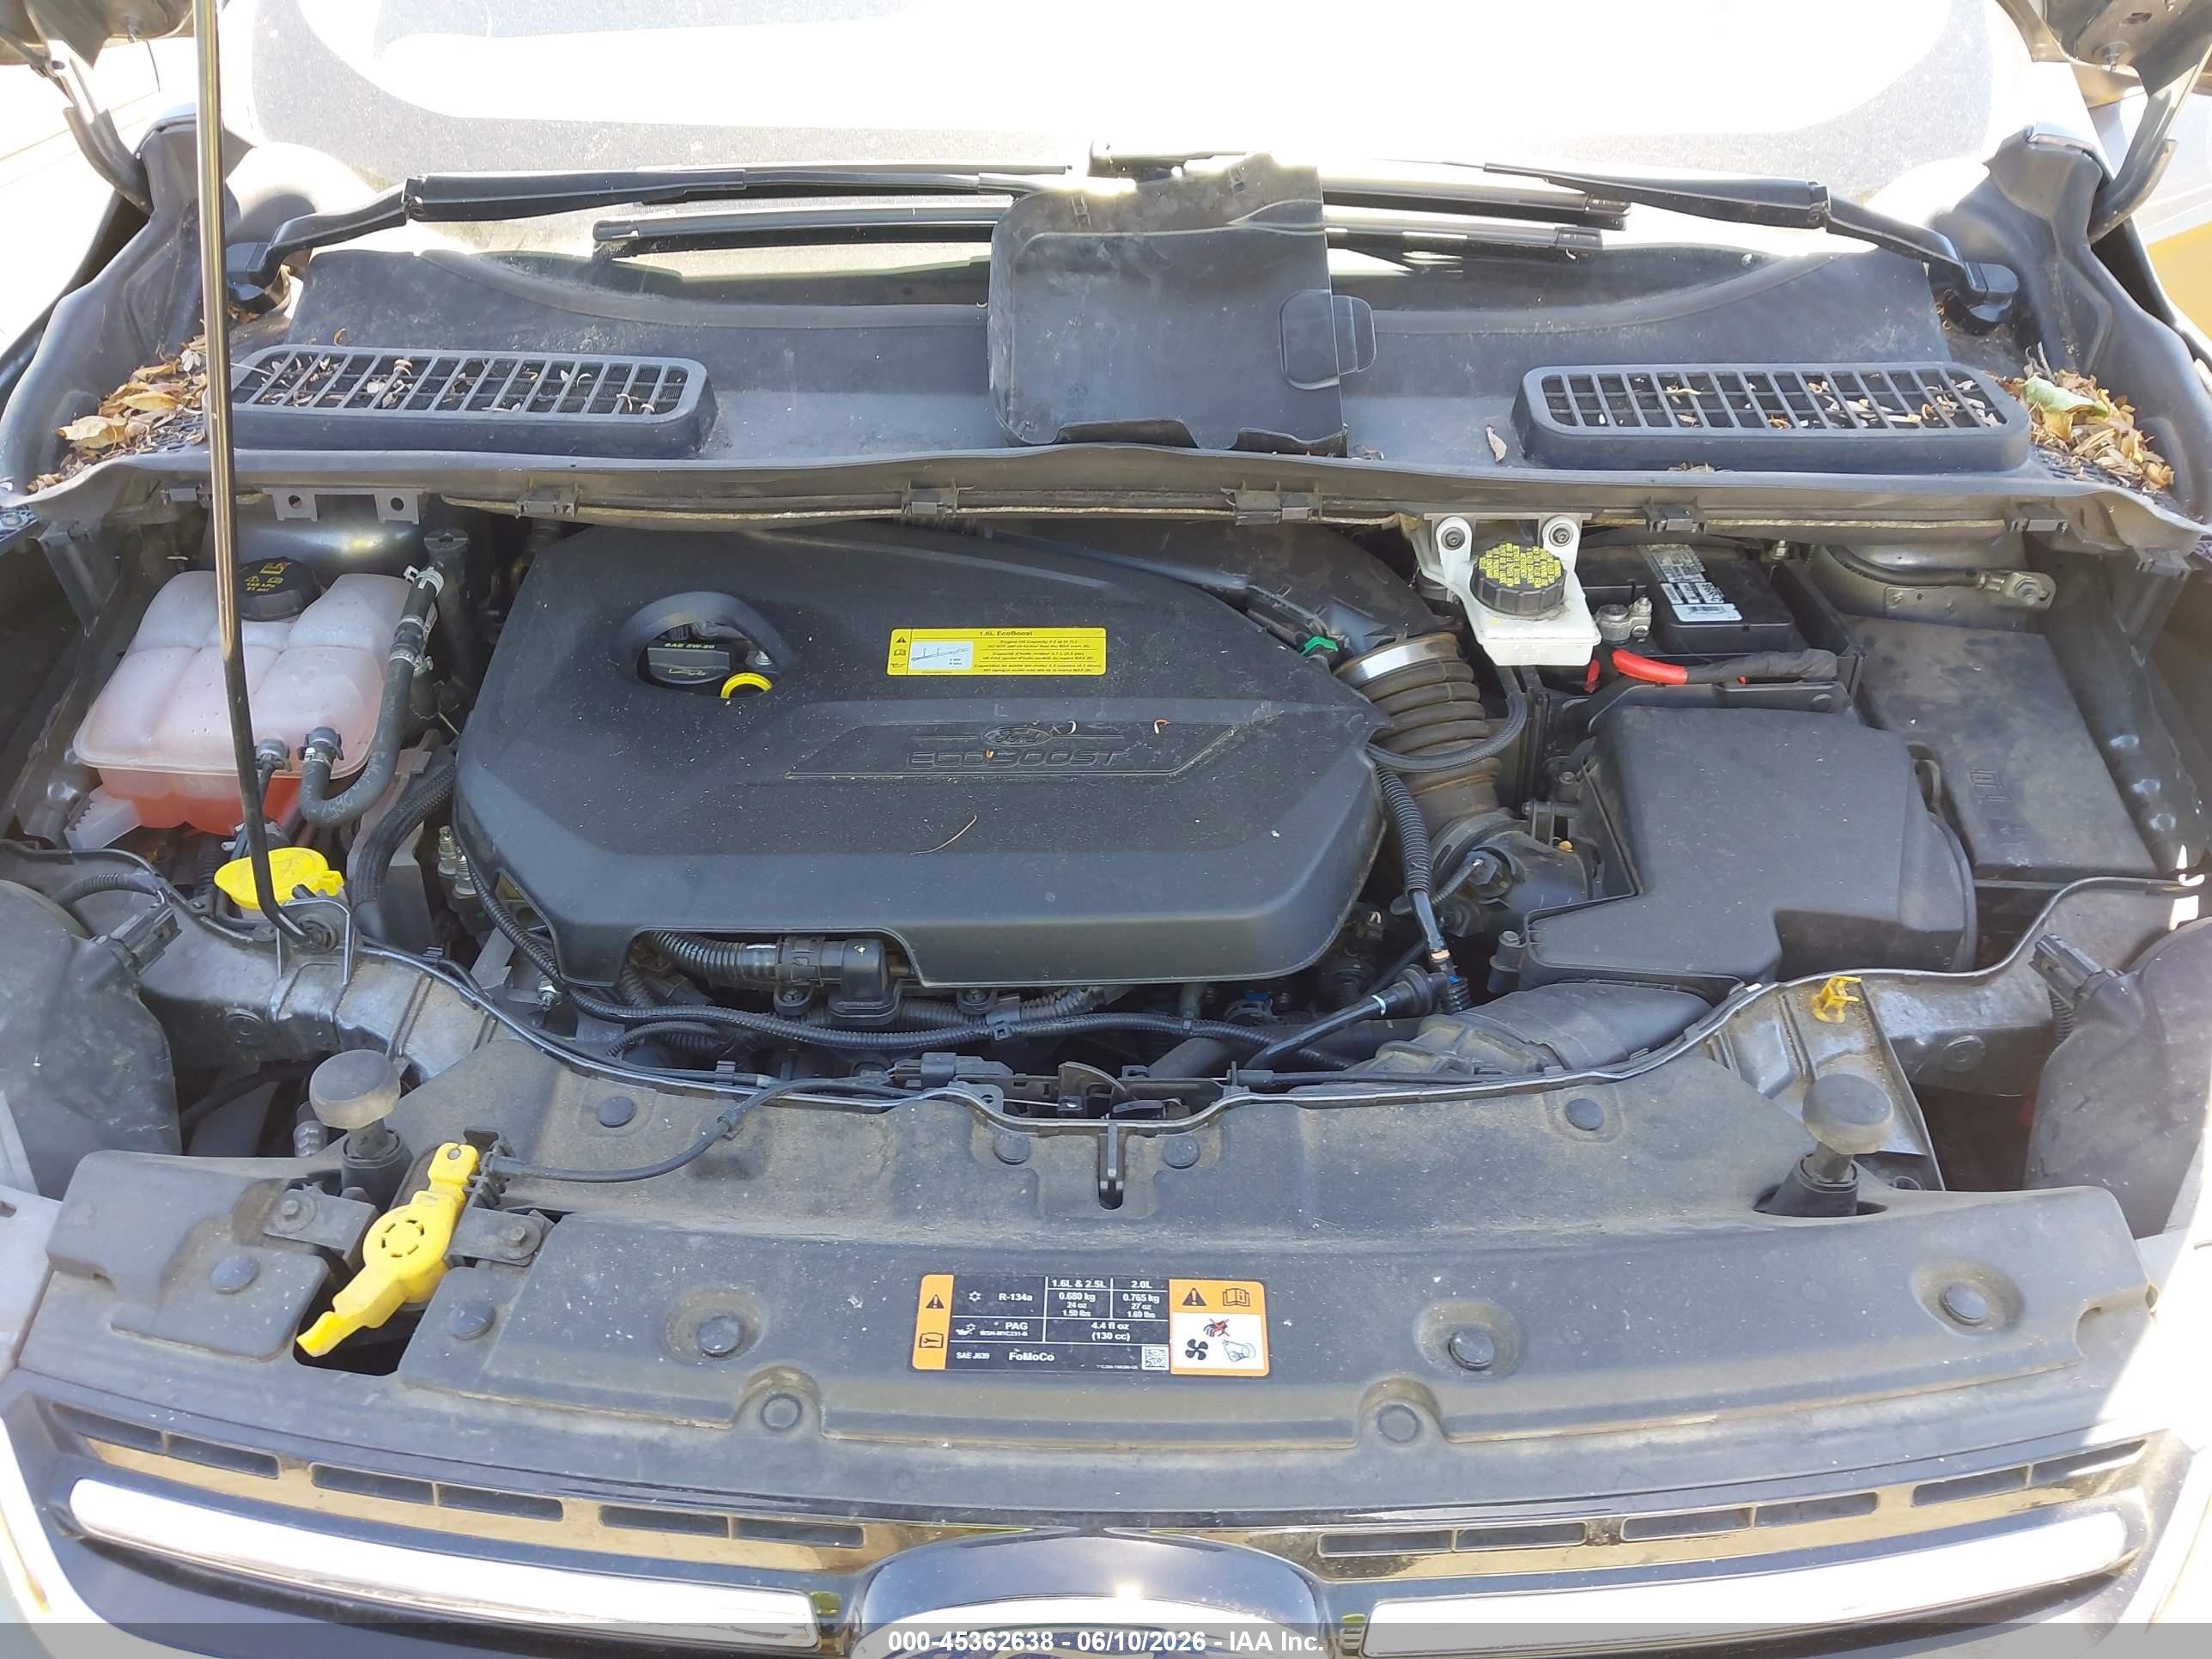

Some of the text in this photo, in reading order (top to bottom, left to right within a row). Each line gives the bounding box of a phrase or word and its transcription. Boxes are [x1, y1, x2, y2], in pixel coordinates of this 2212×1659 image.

[994, 730, 1038, 744] Ford
[908, 750, 1124, 769] ECOBOOST
[1051, 1279, 1107, 1288] 1.6L & 2.5L
[1130, 1280, 1152, 1289] 2.0L
[998, 1292, 1033, 1302] R-134a
[1058, 1291, 1096, 1303] 0.680 kg
[1122, 1292, 1160, 1304] 0.765 kg
[1005, 1322, 1029, 1330] PAG
[1091, 1322, 1107, 1330] 4.4
[1108, 1322, 1115, 1330] fl
[1091, 1332, 1131, 1342] (130 cc)
[1008, 1352, 1055, 1362] FoMoCo
